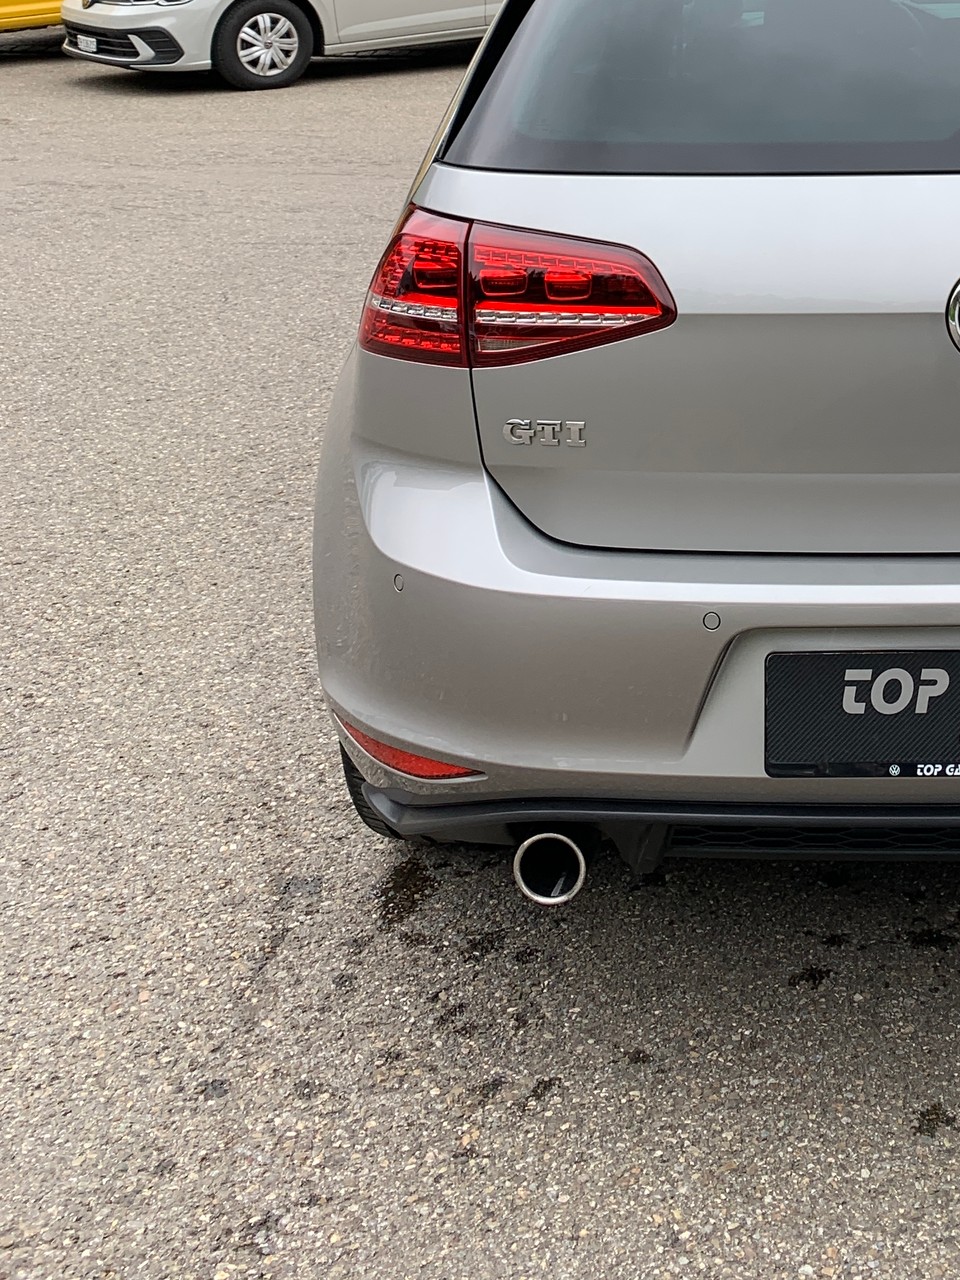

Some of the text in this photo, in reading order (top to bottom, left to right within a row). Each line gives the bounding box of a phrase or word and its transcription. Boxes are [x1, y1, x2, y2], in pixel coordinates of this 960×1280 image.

[502, 419, 587, 447] GTI
[842, 668, 950, 714] TOP
[917, 764, 942, 776] TOP
